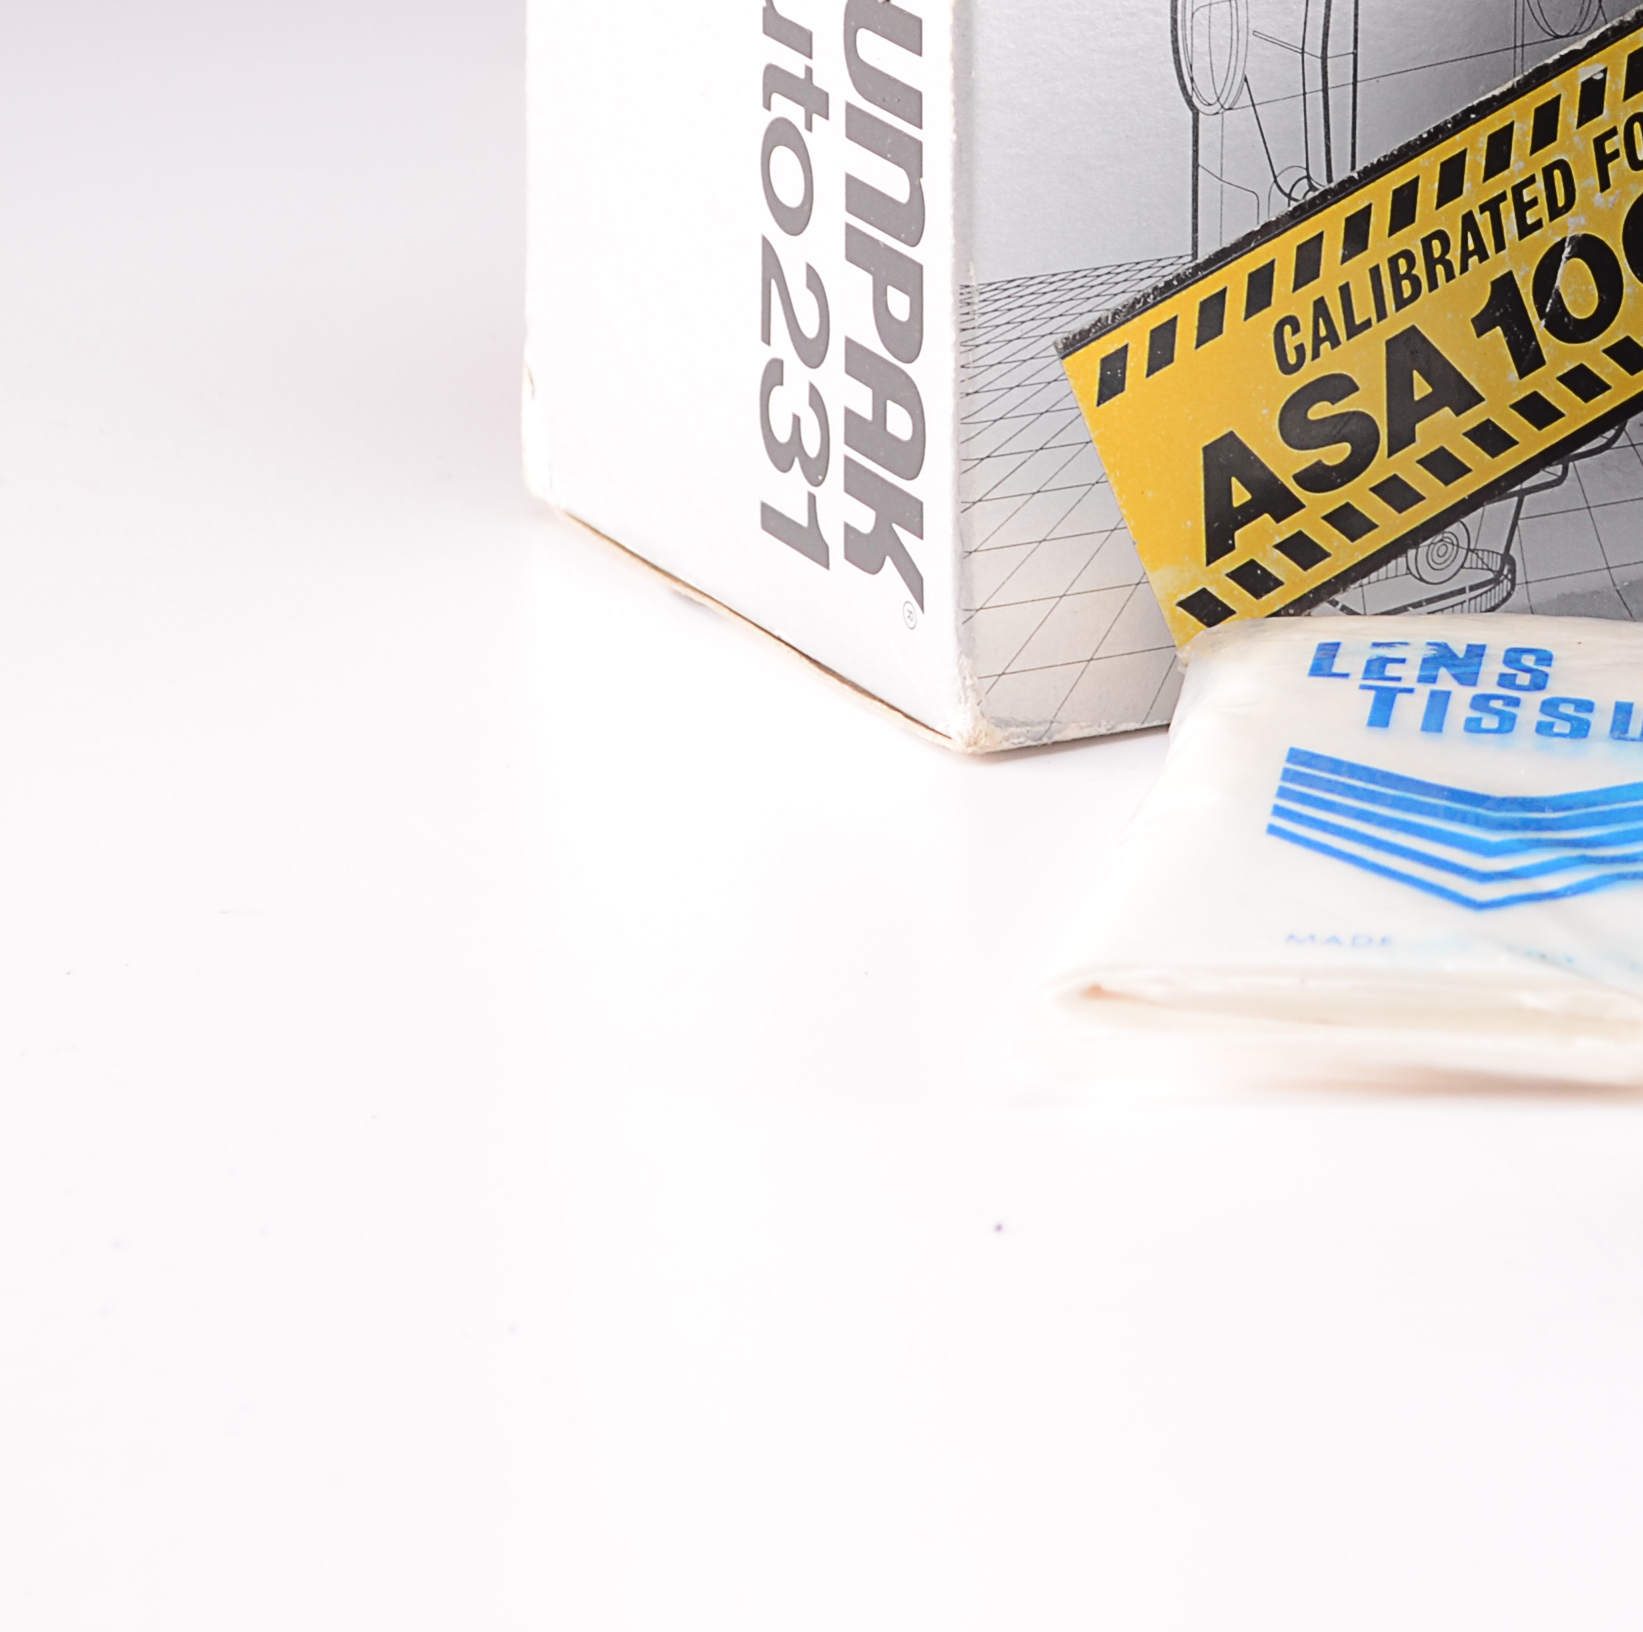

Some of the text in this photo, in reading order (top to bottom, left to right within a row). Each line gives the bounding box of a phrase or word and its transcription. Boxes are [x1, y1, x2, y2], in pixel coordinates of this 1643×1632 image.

[1272, 165, 1577, 375] CALIBRATED
[1201, 325, 1487, 568] ASA
[1306, 640, 1555, 694] LENS
